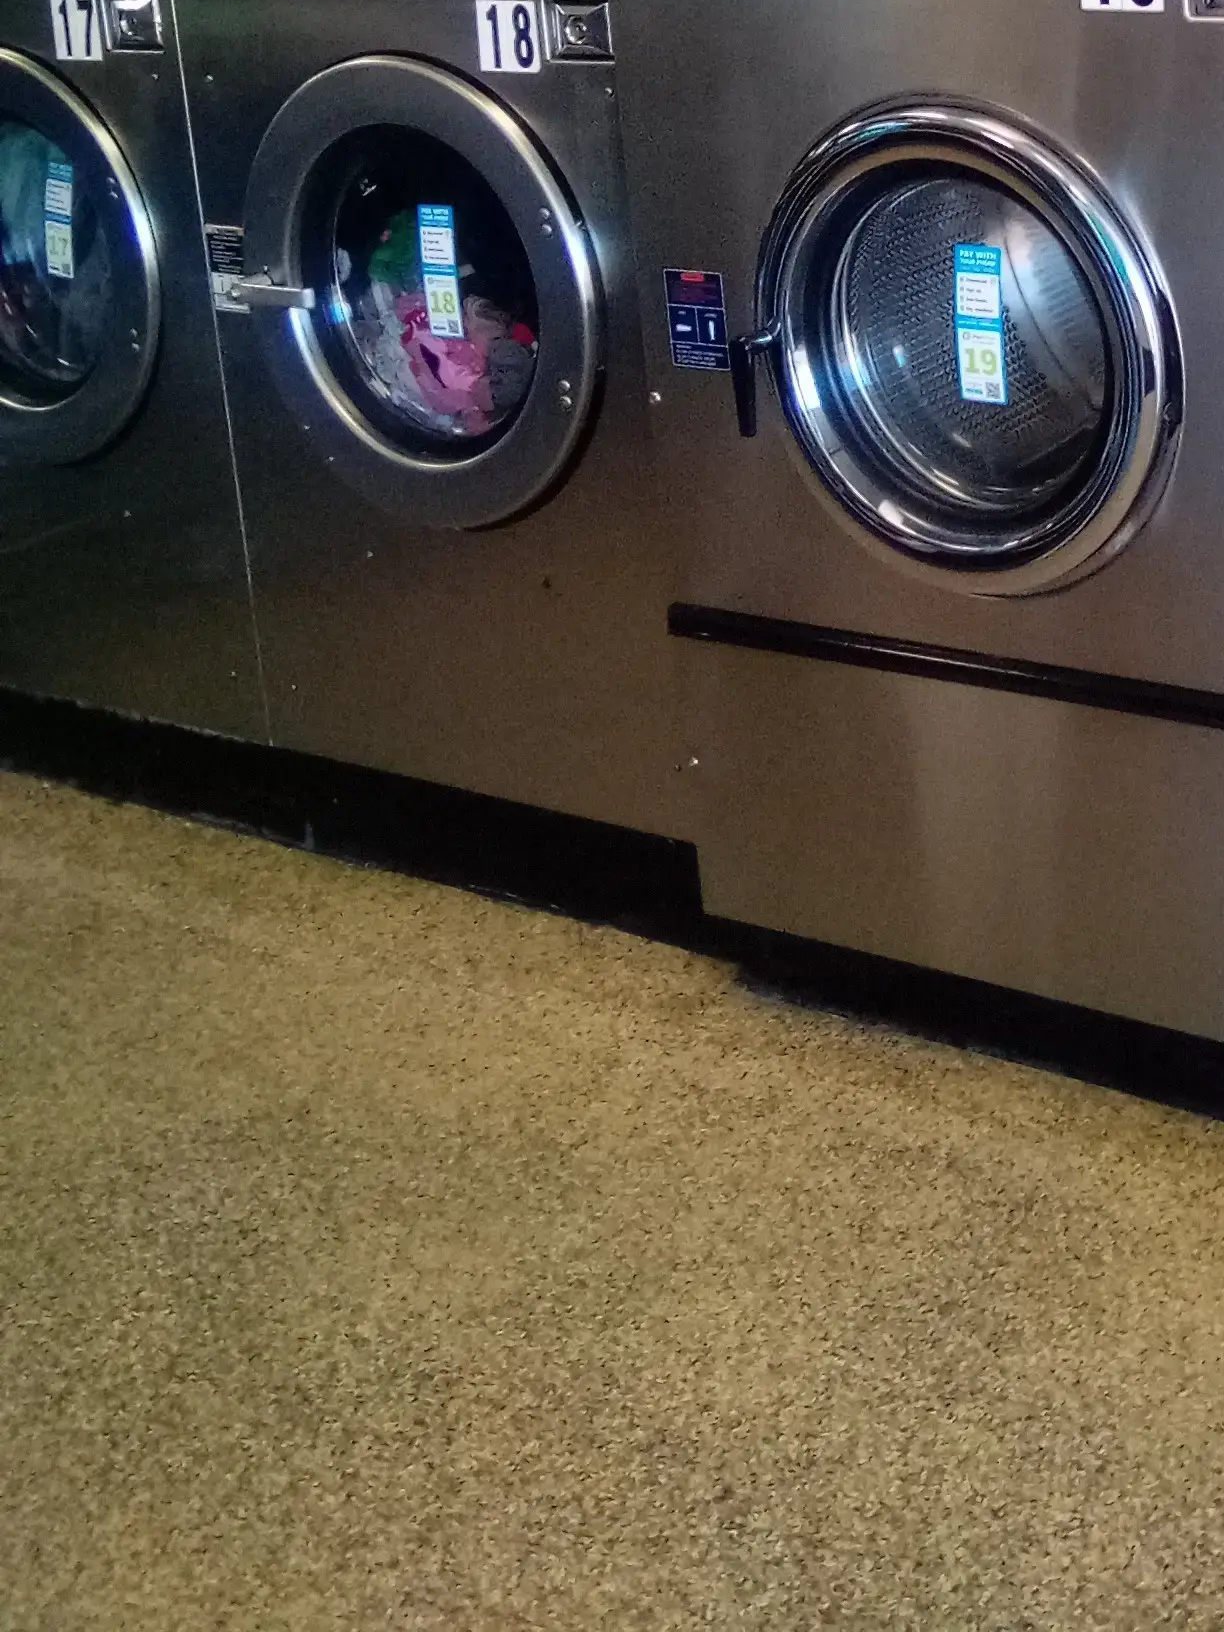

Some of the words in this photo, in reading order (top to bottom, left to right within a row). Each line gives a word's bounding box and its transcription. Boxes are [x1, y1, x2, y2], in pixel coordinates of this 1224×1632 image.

[59, 0, 93, 57] 17
[486, 3, 535, 69] 18
[430, 290, 455, 314] 18
[964, 347, 998, 376] 19
